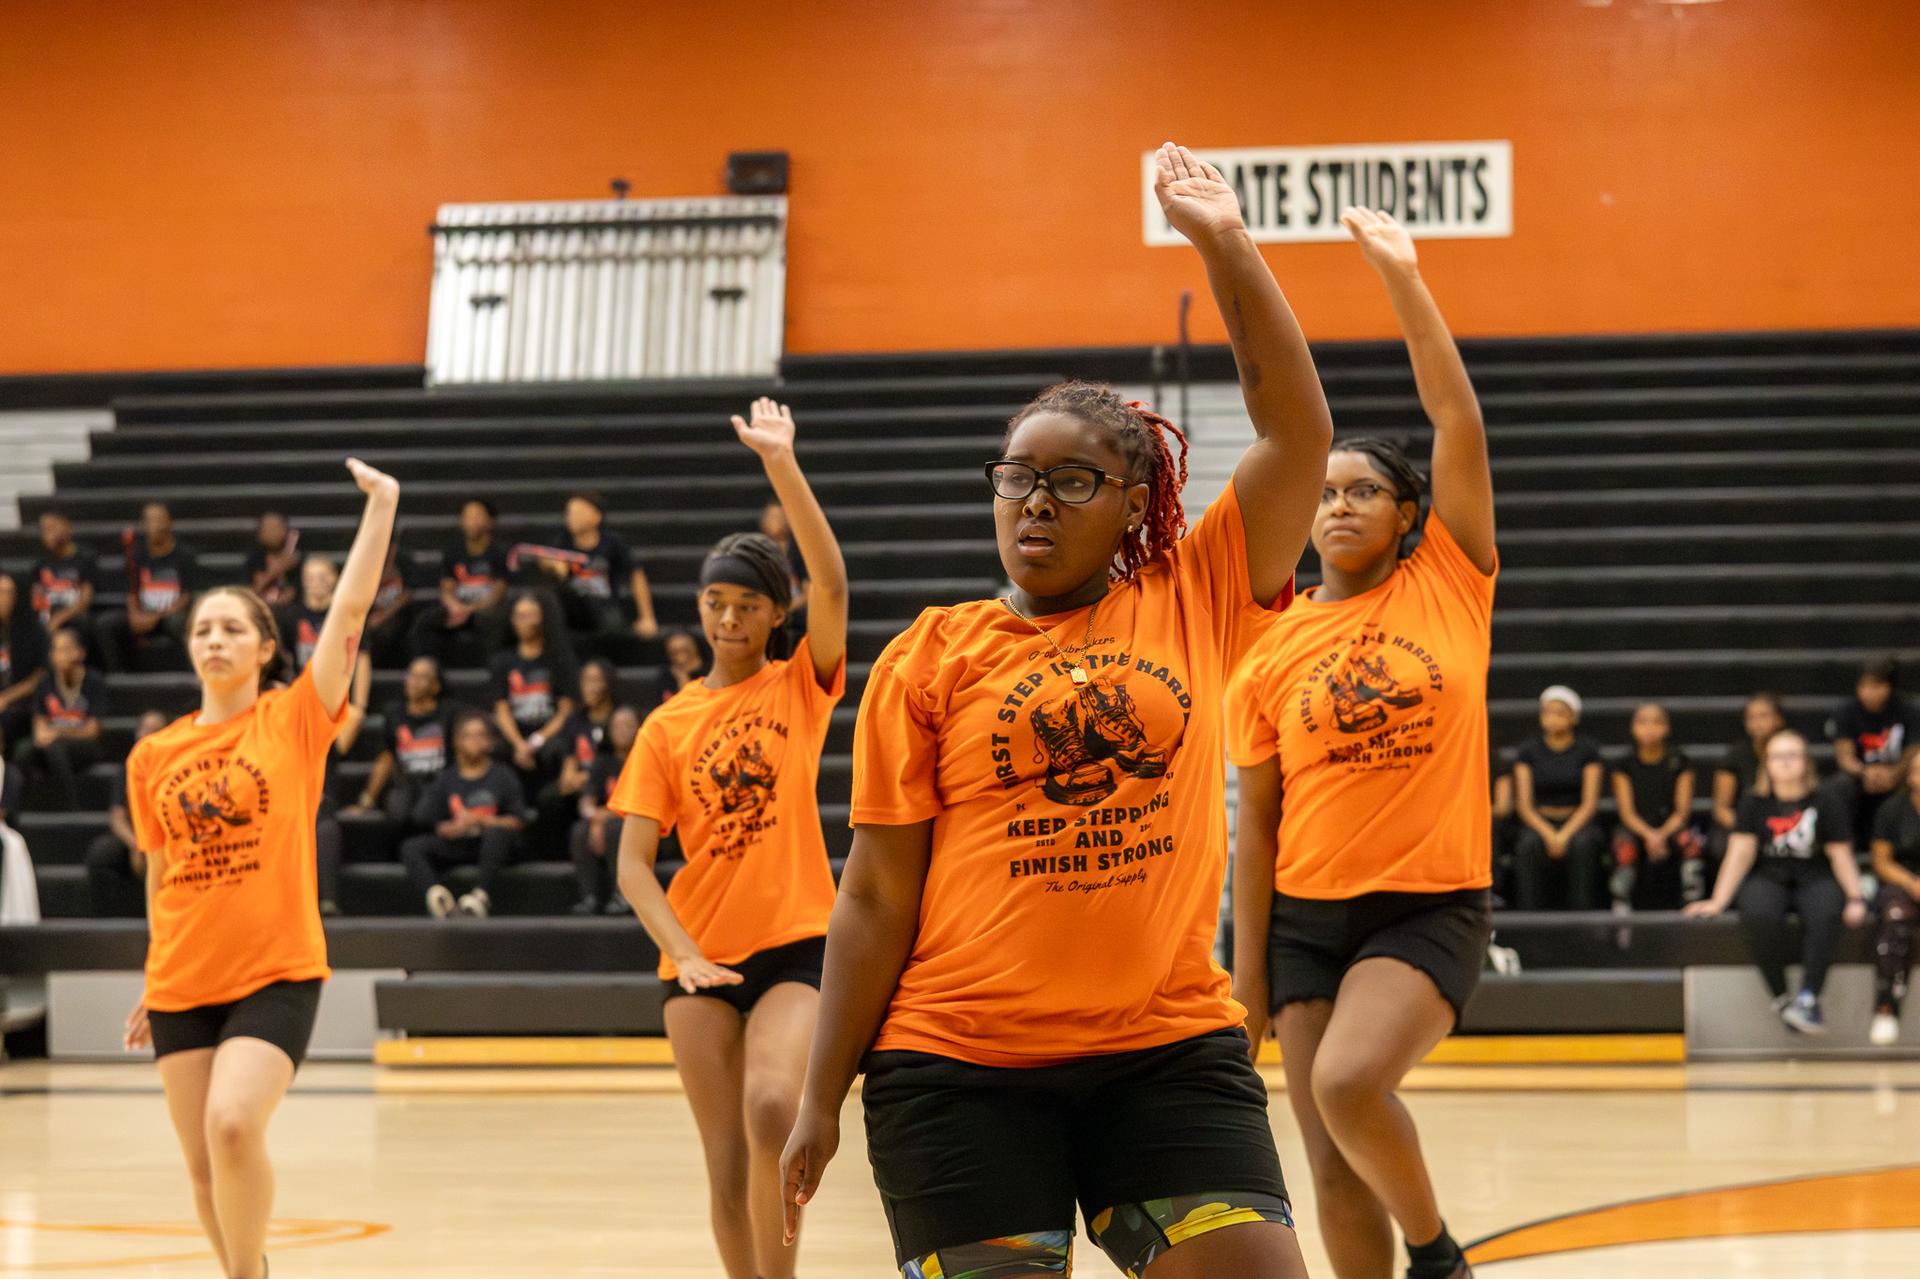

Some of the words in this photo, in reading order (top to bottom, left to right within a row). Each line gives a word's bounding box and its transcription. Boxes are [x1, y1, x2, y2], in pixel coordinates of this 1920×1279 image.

[1307, 156, 1488, 227] STUDENTS
[997, 672, 1044, 724] STEP
[1049, 660, 1077, 677] IS
[1086, 651, 1132, 670] THE
[1392, 635, 1443, 693] HARDEST
[1007, 817, 1067, 837] KEEP
[1074, 790, 1169, 827] STEPPING
[1010, 854, 1088, 878] FINISH
[1097, 835, 1173, 871] STRONG
[1074, 829, 1123, 849] AND
[1045, 881, 1065, 893] The
[1067, 875, 1114, 894] Original
[1114, 869, 1147, 887] Supply
